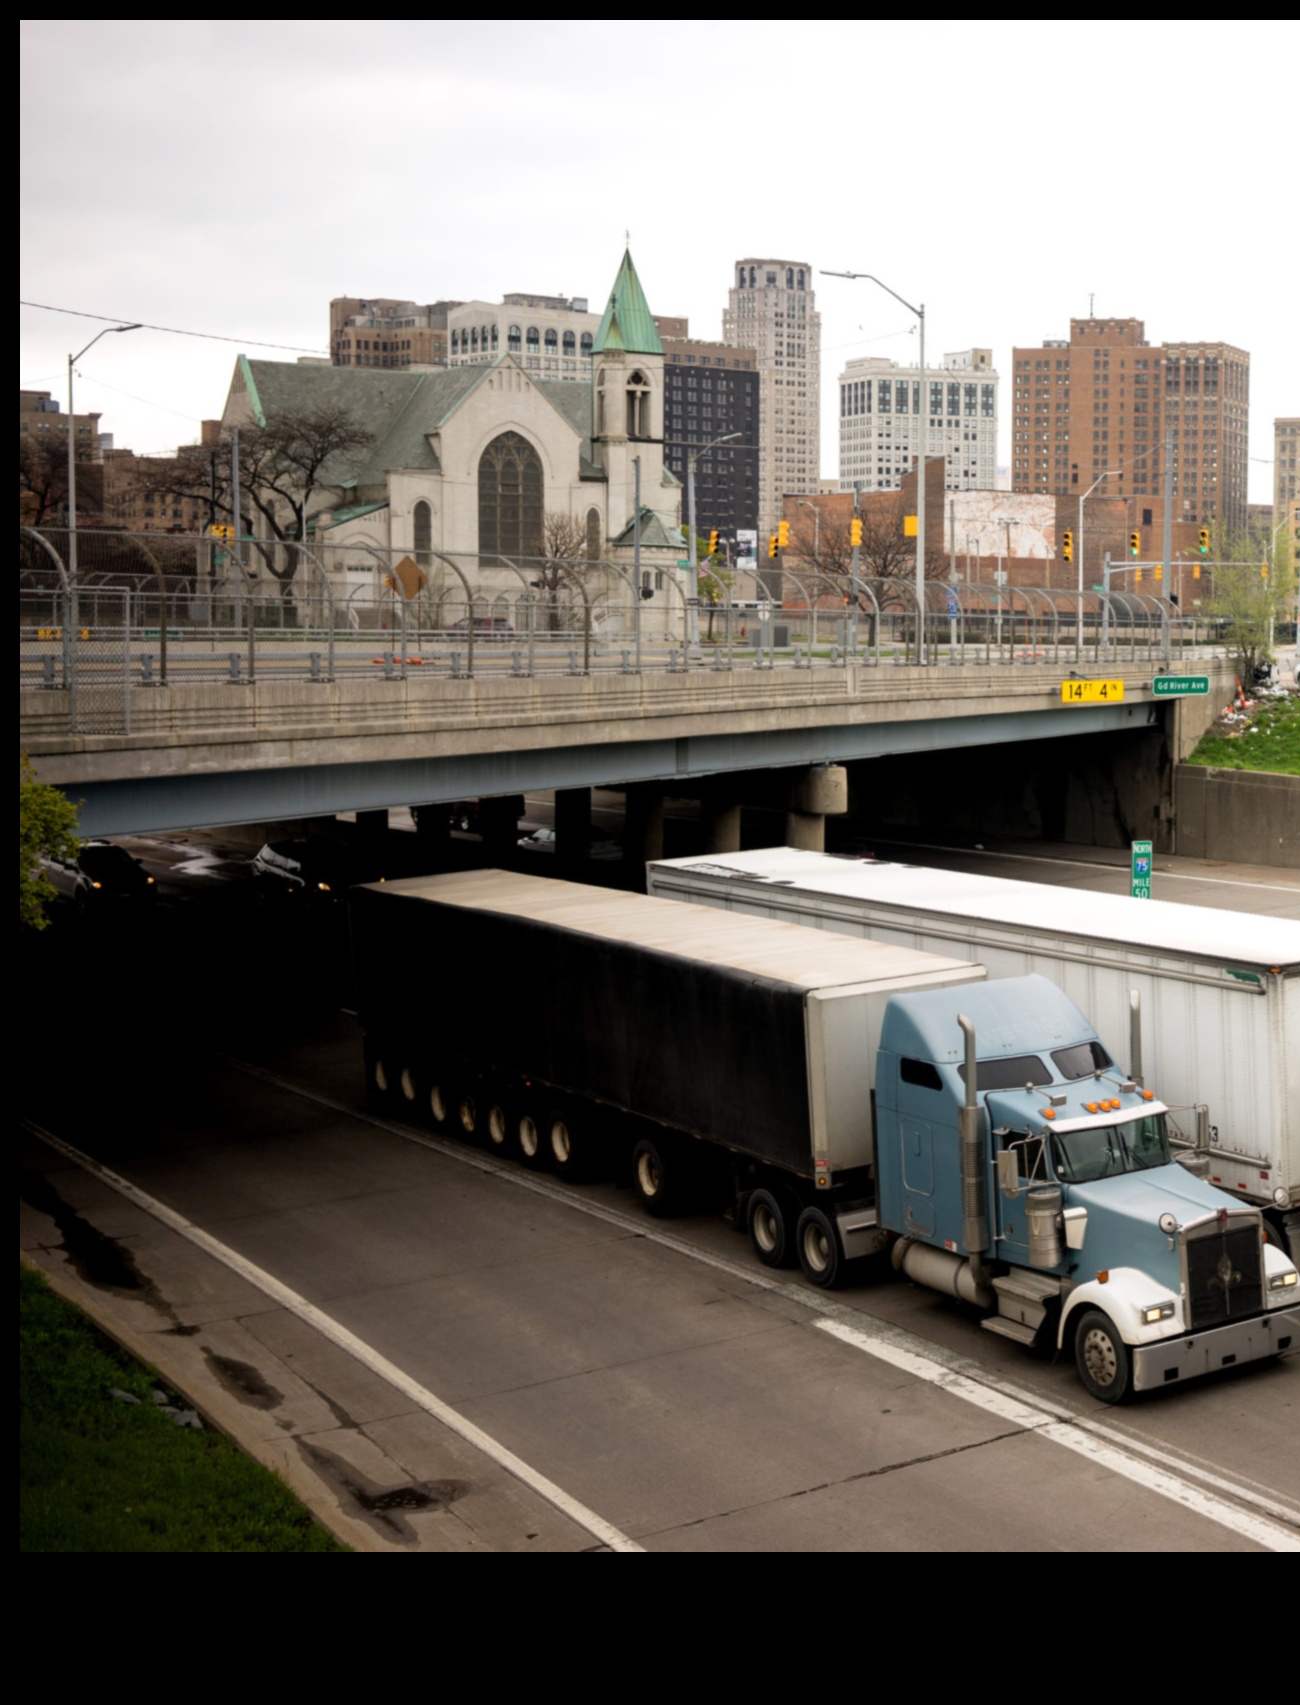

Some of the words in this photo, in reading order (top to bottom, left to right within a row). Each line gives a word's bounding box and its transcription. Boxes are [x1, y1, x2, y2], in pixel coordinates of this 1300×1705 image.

[1157, 681, 1168, 690] Gd
[1169, 681, 1189, 690] River
[1191, 681, 1205, 689] Ave
[1069, 684, 1082, 699] 14
[1084, 683, 1093, 692] FT
[1099, 683, 1108, 698] 4
[1132, 845, 1152, 853] NORTH
[1137, 861, 1148, 870] 75
[1133, 878, 1150, 887] MILE
